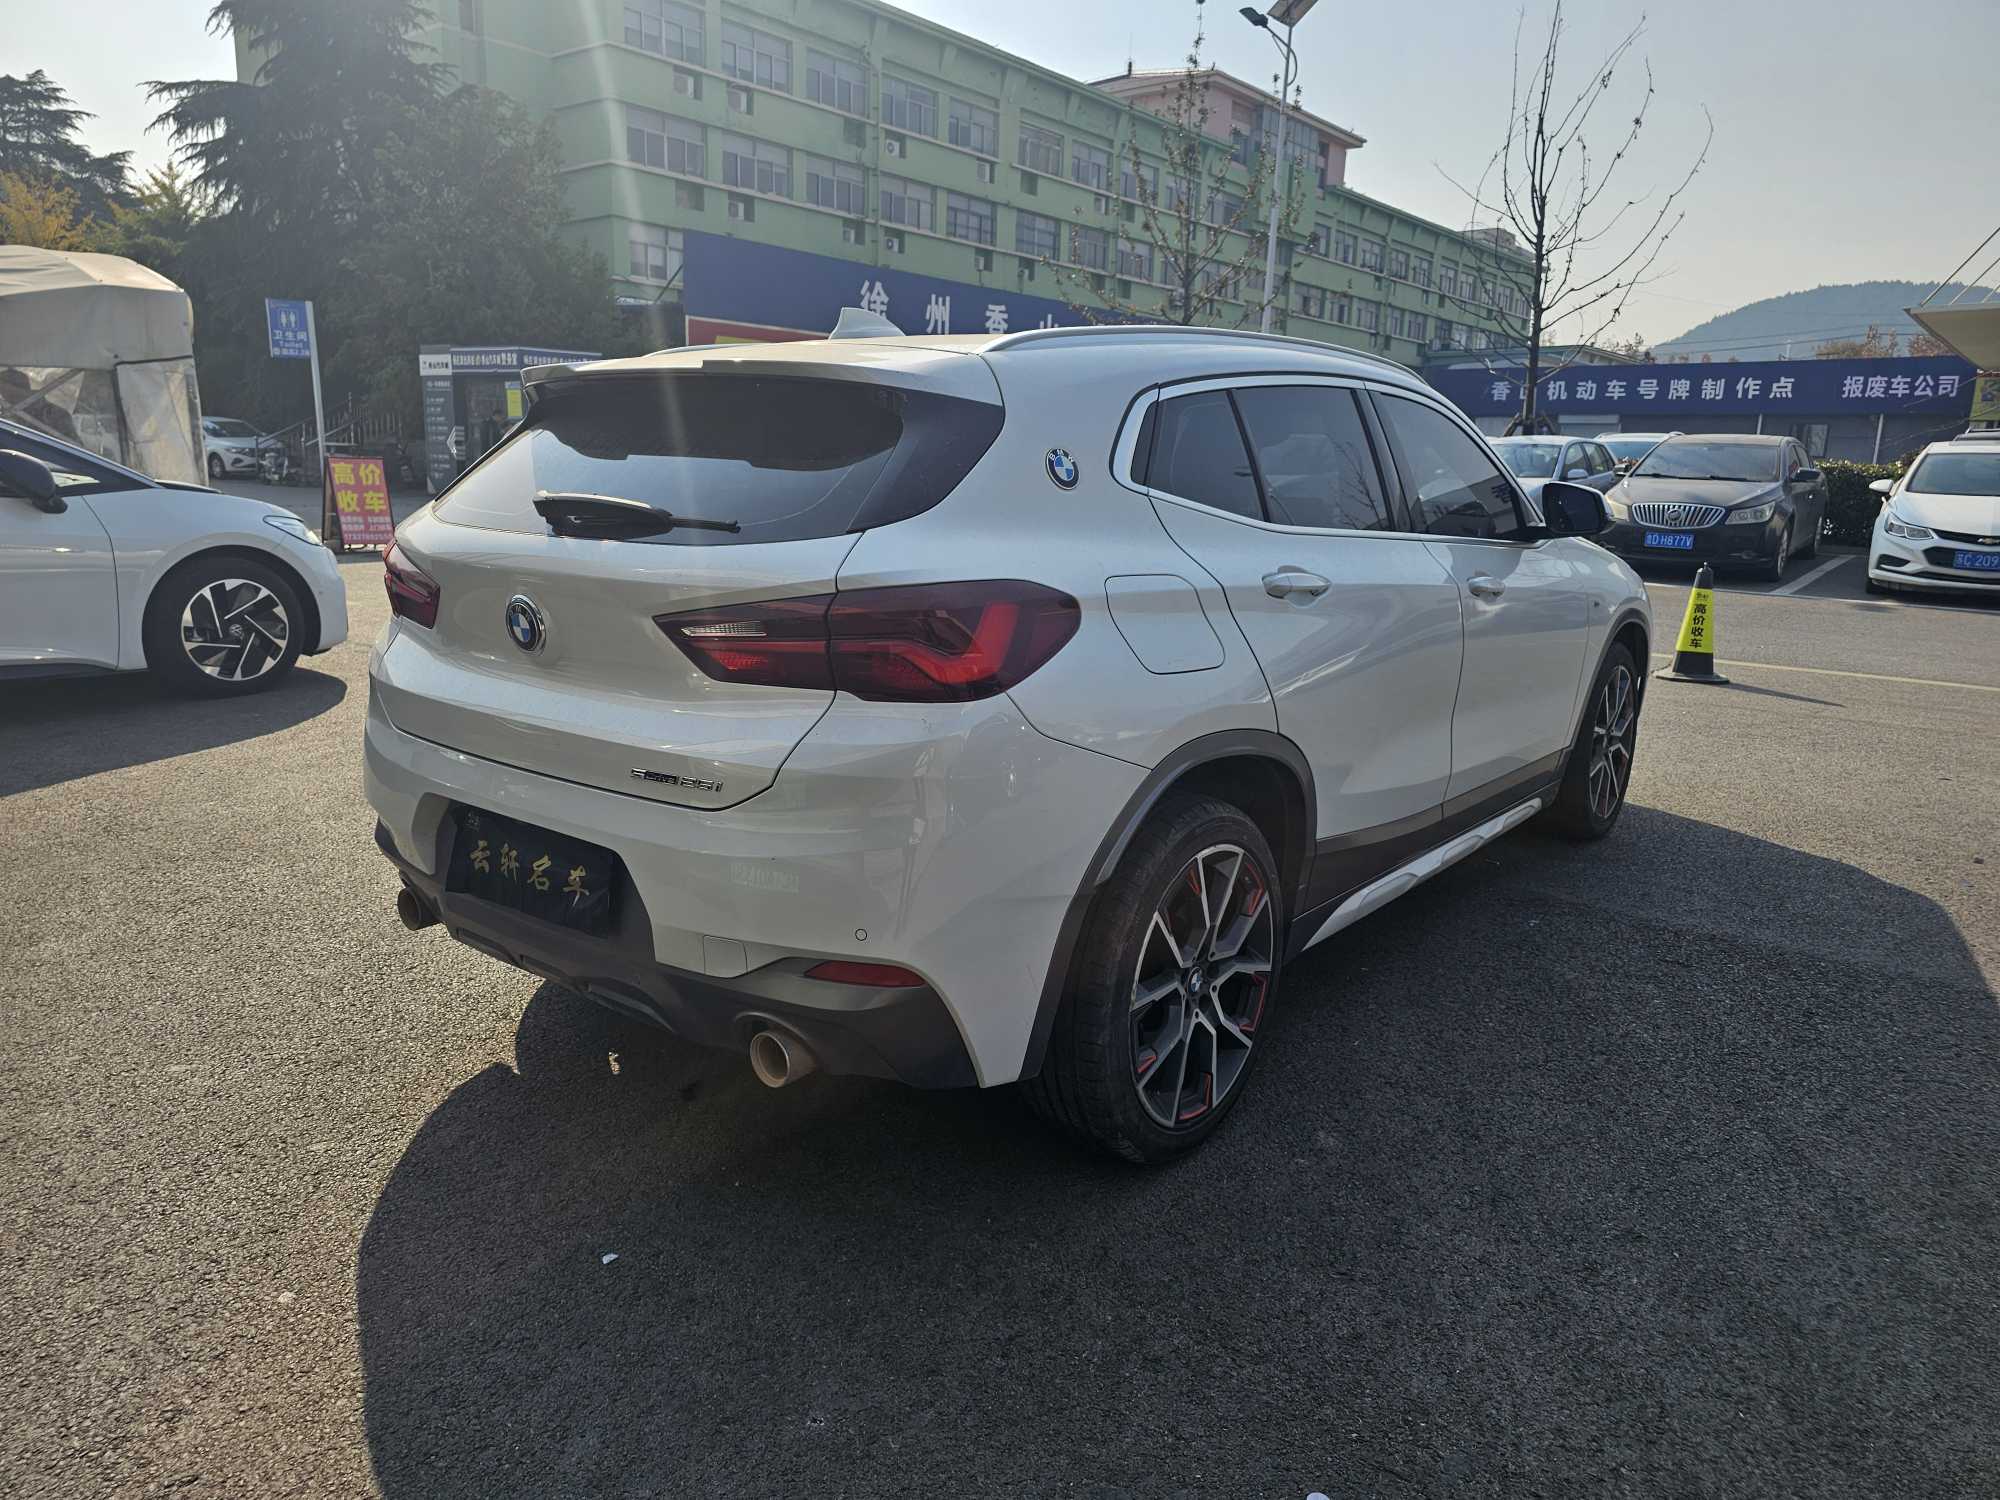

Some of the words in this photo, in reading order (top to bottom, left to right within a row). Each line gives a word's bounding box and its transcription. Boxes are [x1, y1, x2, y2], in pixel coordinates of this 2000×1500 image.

[1841, 375, 1960, 398] 报废车公司
[332, 463, 382, 486] 高价
[336, 489, 386, 513] 收车
[1689, 604, 1707, 649] 高价收车
